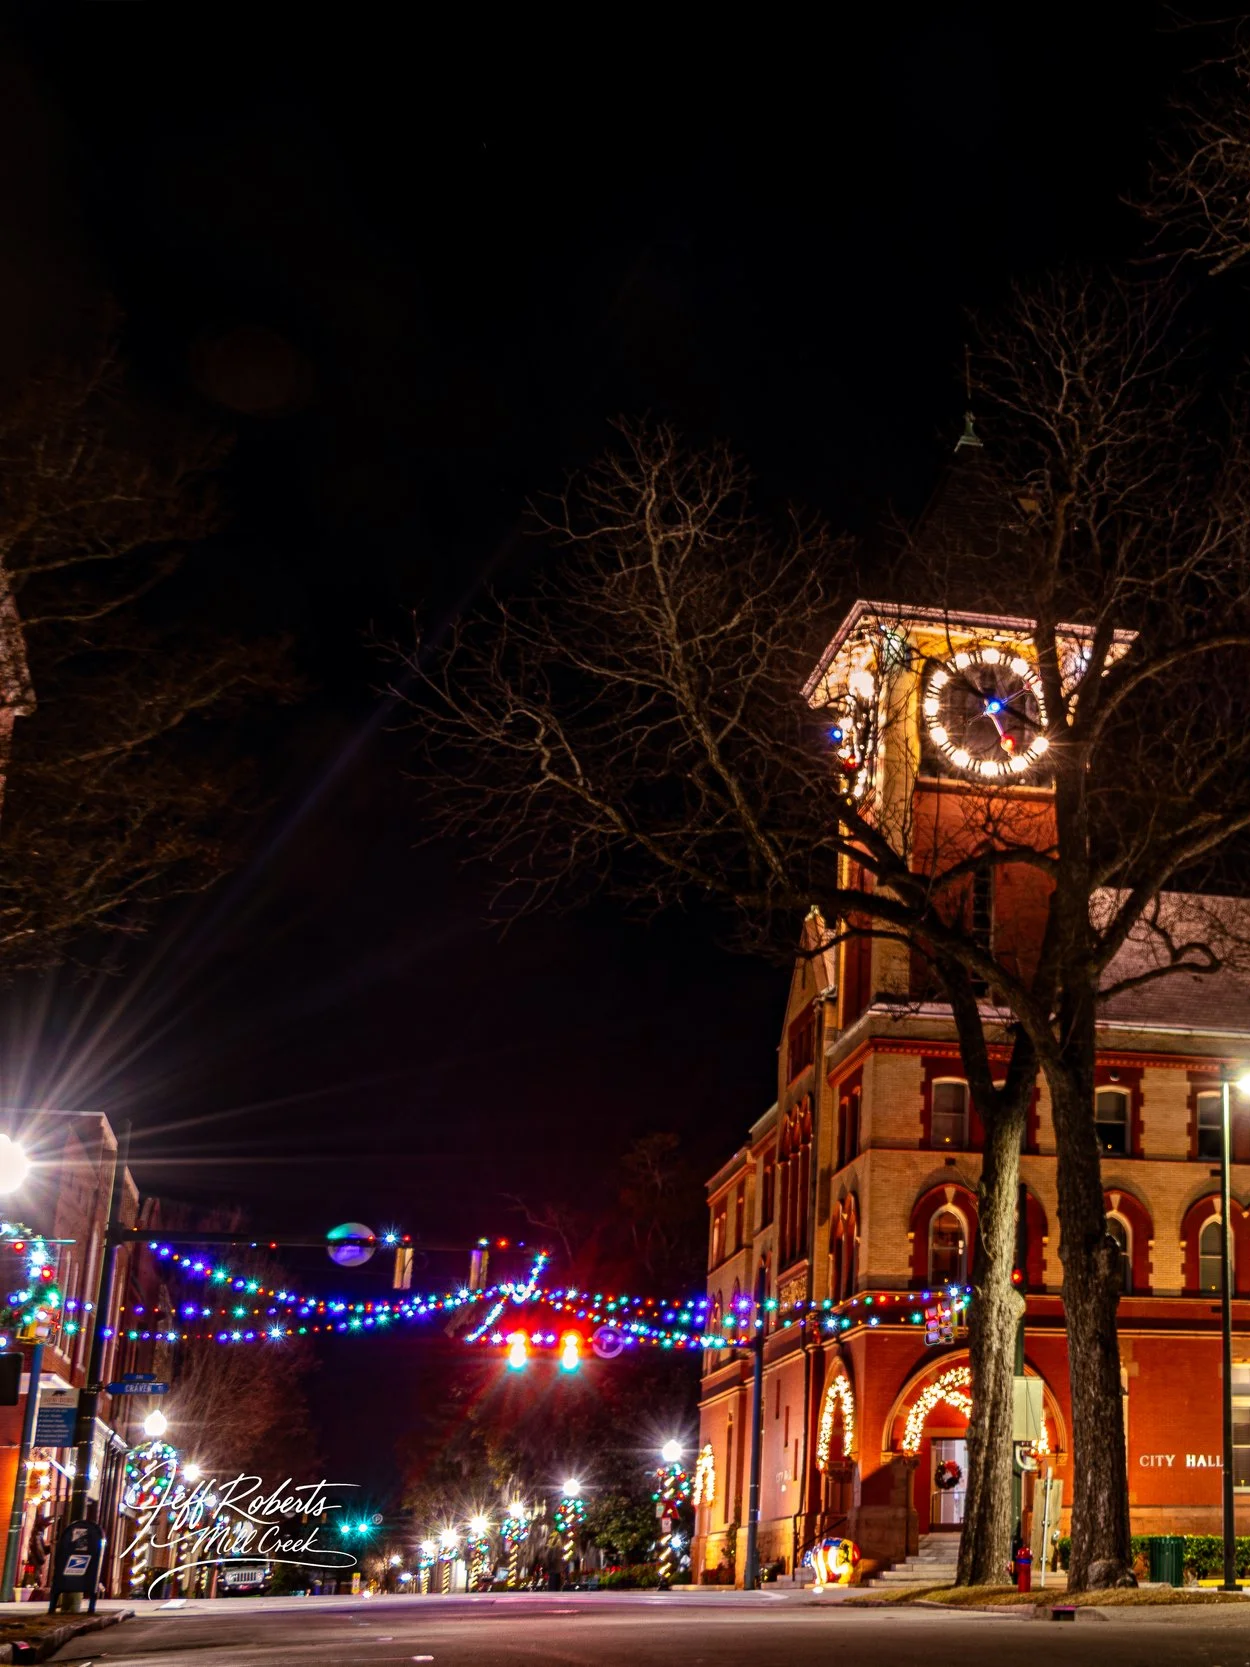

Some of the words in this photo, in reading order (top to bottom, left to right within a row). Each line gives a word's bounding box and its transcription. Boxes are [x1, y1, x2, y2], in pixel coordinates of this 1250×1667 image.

[124, 1384, 152, 1393] CRAVEN
[1139, 1454, 1176, 1468] CITY
[1185, 1454, 1224, 1468] HALL
